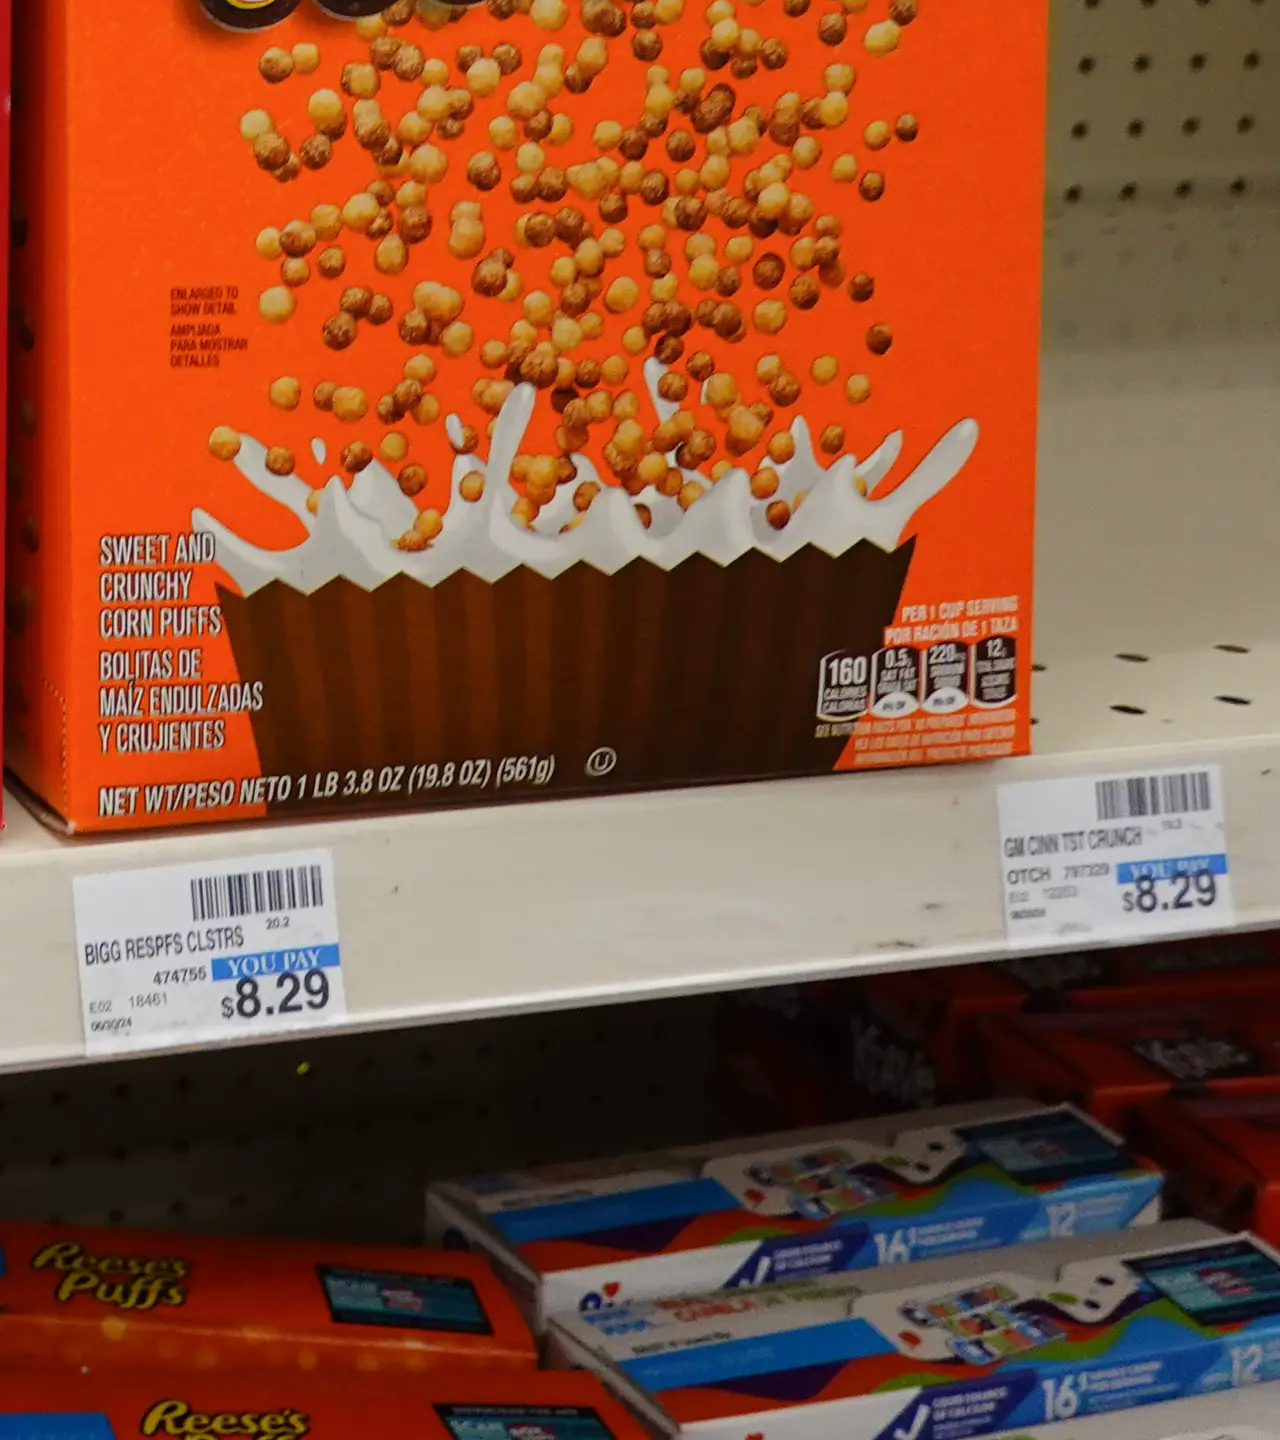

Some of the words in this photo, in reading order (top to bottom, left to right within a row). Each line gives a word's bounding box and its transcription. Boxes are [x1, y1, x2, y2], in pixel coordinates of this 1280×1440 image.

[100, 534, 169, 565] SWEET
[175, 532, 215, 564] AND
[100, 571, 191, 602] CRUNCHY
[100, 608, 153, 638] CORN
[160, 605, 222, 636] PUFFS
[100, 649, 173, 681] BOLITAS
[178, 649, 202, 679] DE
[100, 679, 144, 717] MAÍZ
[150, 681, 263, 716] ENDULZADAS
[99, 724, 112, 754] Y
[117, 719, 225, 752] CRUJIENTES
[98, 786, 139, 817] NET
[143, 784, 235, 814] WT/PESO
[239, 774, 291, 805] NETO
[296, 774, 308, 800] 1
[313, 771, 339, 799] LB
[343, 768, 374, 796] 3.8
[378, 765, 404, 793] OZ
[408, 760, 455, 794] (19.8
[458, 758, 493, 790] OZ)
[496, 755, 555, 787] (561g)
[1007, 866, 1051, 885] OTCH
[1122, 868, 1217, 912] $8.29
[85, 940, 121, 965] BIGG
[126, 932, 183, 959] RESPFS
[187, 926, 244, 953] CLSTRS
[153, 966, 206, 985] 474755
[228, 955, 276, 977] YOU
[283, 949, 321, 969] PAY
[221, 967, 329, 1019] $8.29
[56, 1271, 187, 1309] Puffs
